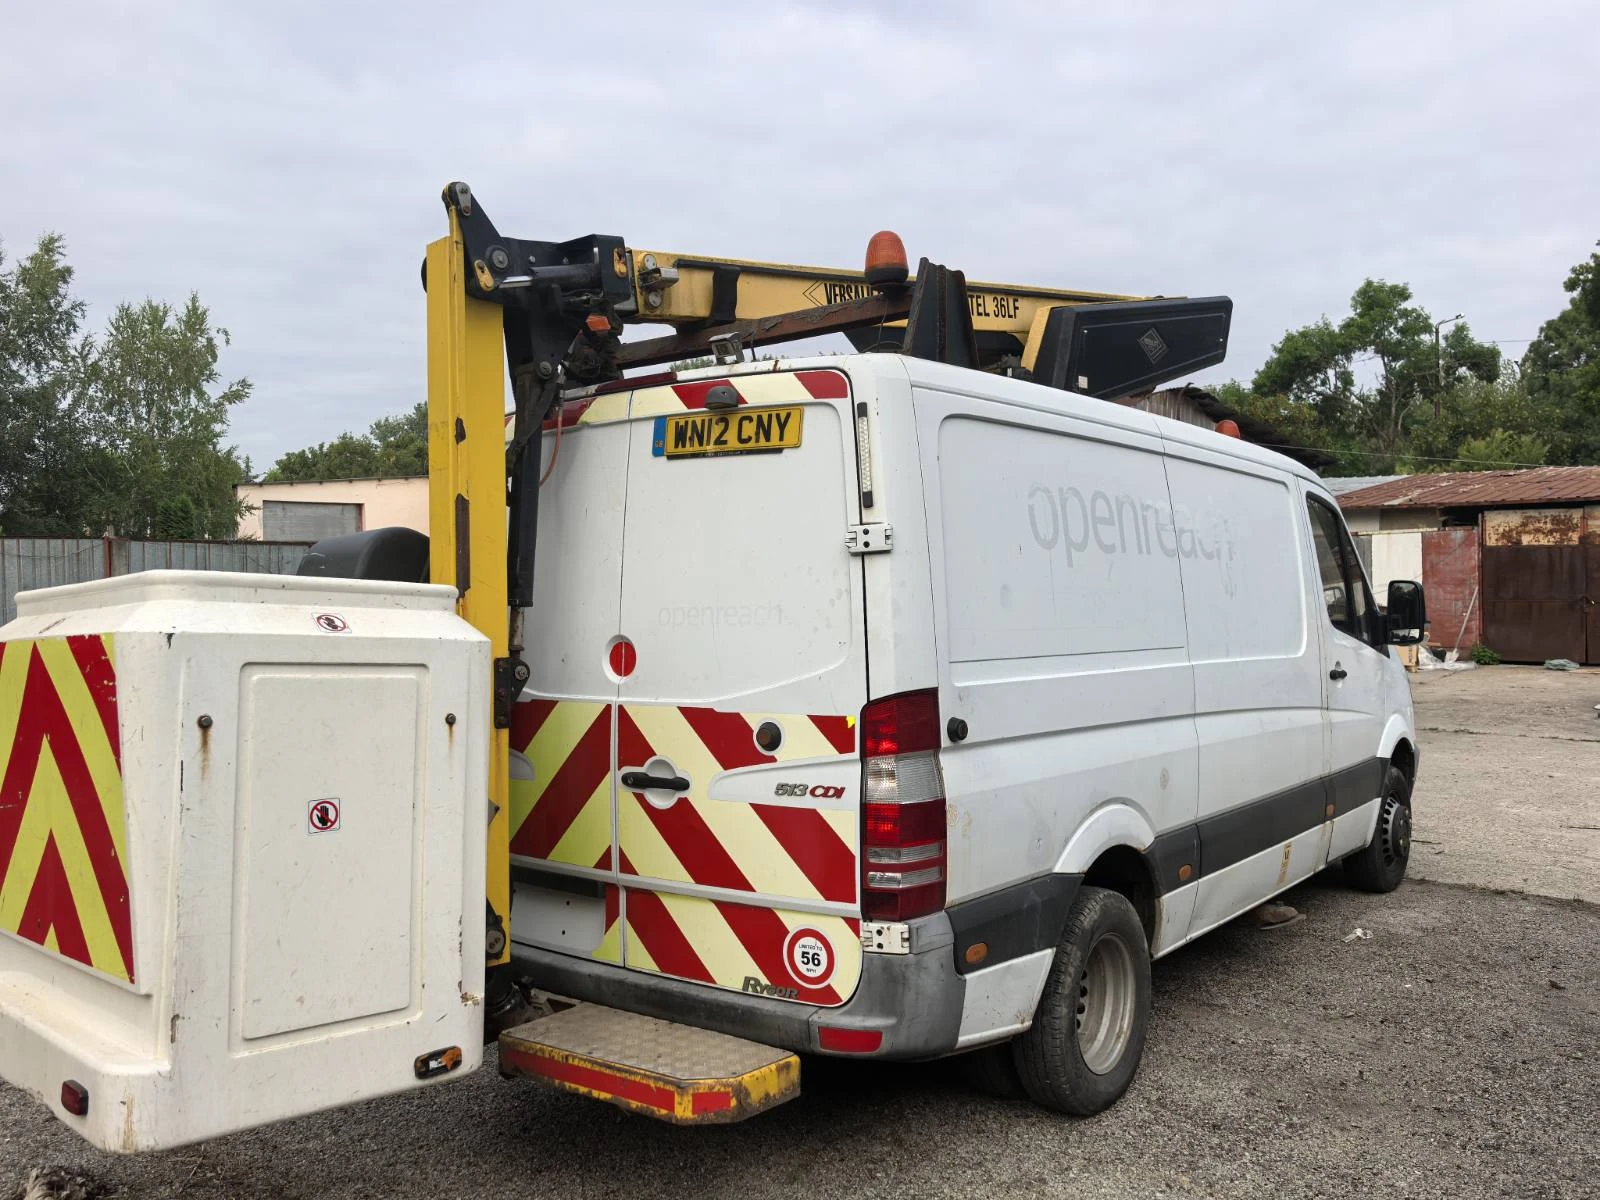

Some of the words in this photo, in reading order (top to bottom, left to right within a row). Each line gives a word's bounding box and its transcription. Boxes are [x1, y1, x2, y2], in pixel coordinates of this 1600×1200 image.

[967, 294, 990, 317] TEL
[992, 296, 1020, 319] 36LF
[673, 417, 730, 448] WN12
[737, 411, 792, 445] CNY
[774, 782, 809, 797] 513
[809, 785, 846, 799] CDI
[801, 951, 821, 967] 56
